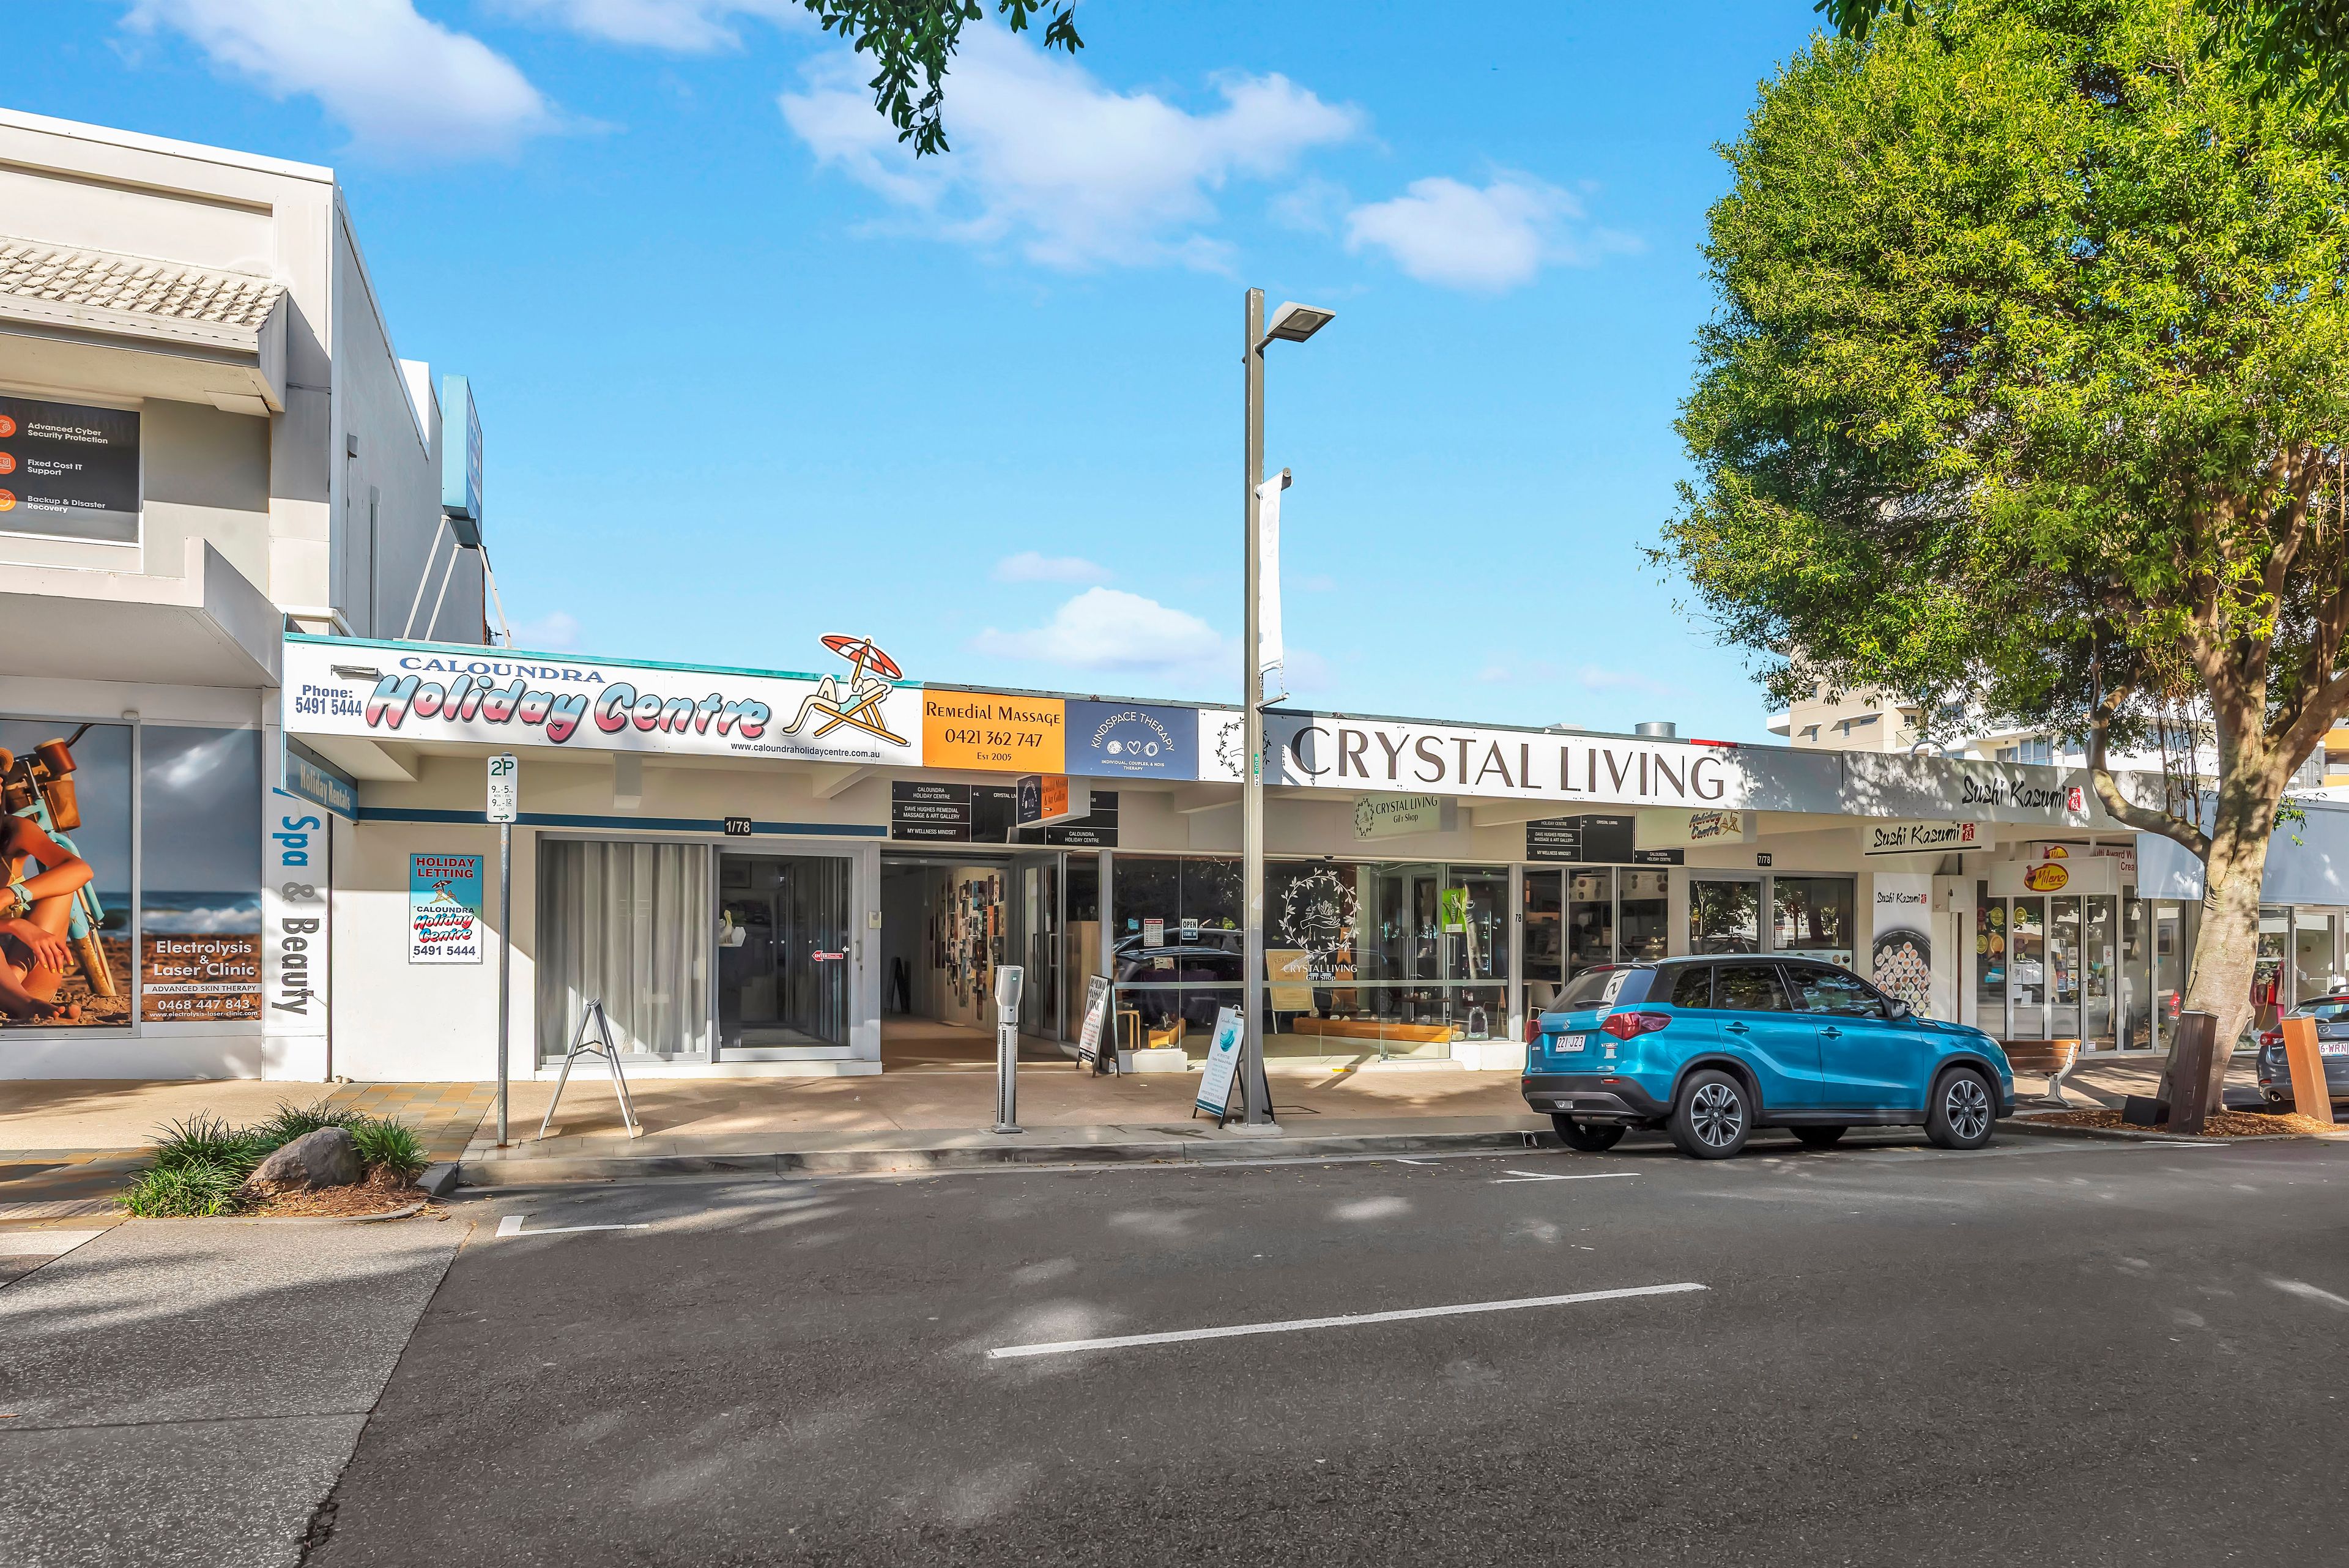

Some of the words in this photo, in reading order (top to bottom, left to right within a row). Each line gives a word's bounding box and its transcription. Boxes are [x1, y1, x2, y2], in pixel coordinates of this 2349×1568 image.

[28, 422, 73, 433] Advanced
[75, 427, 102, 436] Cyber
[28, 429, 62, 440] Security
[65, 434, 108, 444] Protection
[28, 459, 51, 467] Fixed
[28, 467, 62, 476] Support
[28, 496, 61, 505] Backup
[28, 503, 69, 513] Recovery
[399, 657, 606, 683] CALOUNDRA
[302, 684, 354, 699] Phone:
[295, 696, 327, 715] 5491
[331, 699, 362, 716] 5444
[366, 674, 590, 744] Holiday
[595, 682, 772, 740] Centre
[945, 729, 980, 744] 0421
[986, 731, 1011, 746] 362
[1017, 733, 1042, 747] 747
[1091, 712, 1137, 749] KINDSPACE
[1140, 713, 1175, 751] THERAPY
[731, 742, 880, 759] www.caloundraholidaycentre.com.au
[491, 760, 514, 776] 2P
[1291, 726, 1542, 790] CRYSTAL
[1561, 746, 1724, 800] LIVING
[300, 764, 327, 804] Holiday
[328, 780, 351, 811] Rentals
[1962, 775, 2005, 806] Sushi
[2010, 780, 2067, 809] Kasumi
[1376, 799, 1408, 814] CRYSTAL
[1411, 796, 1438, 810] LIVING
[726, 821, 750, 833] 1/78
[1689, 811, 1723, 828] Holiday
[1691, 825, 1719, 839] Centre
[1874, 826, 1907, 848] Sushi
[1911, 823, 1961, 845] Kasumi
[273, 816, 320, 866] Spa
[416, 857, 475, 868] HOLIDAY
[417, 868, 473, 878] LETTING
[2035, 870, 2066, 886] Milano
[282, 882, 315, 902] &
[1877, 892, 1894, 903] Sushi
[1896, 892, 1920, 904] Kasumi
[414, 913, 474, 930] Holiday
[1515, 913, 1521, 922] 78
[418, 927, 472, 943] Centre
[157, 940, 251, 956] Electrolysis
[414, 946, 441, 956] 5491
[447, 946, 475, 956] 5444
[199, 955, 209, 964] &
[272, 918, 320, 1015] Beauty
[154, 964, 201, 976] Laser
[207, 963, 254, 976] Clinic
[158, 1000, 191, 1009] 0468
[196, 1000, 221, 1009] 447
[225, 1000, 250, 1009] 843
